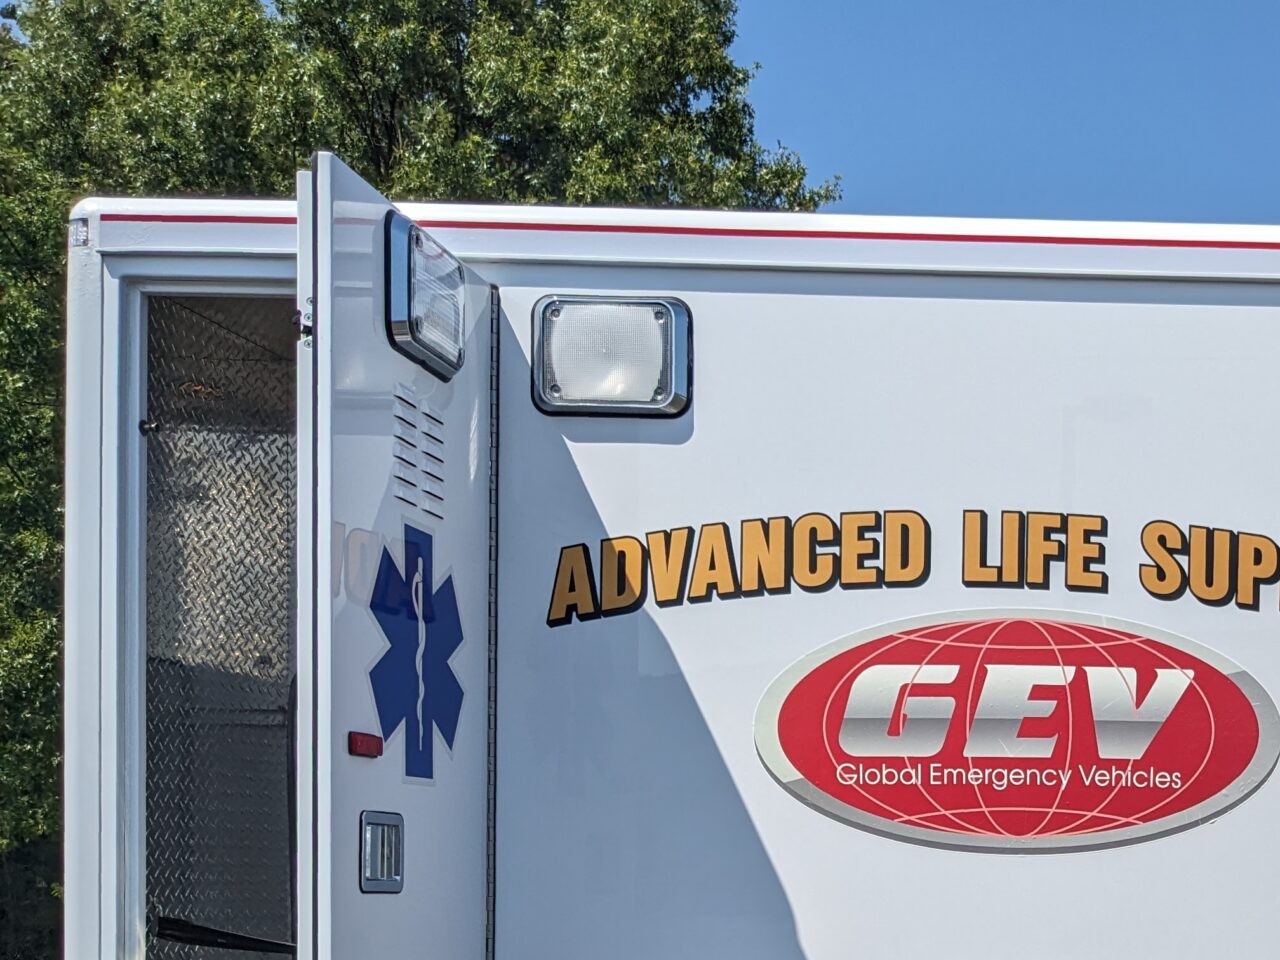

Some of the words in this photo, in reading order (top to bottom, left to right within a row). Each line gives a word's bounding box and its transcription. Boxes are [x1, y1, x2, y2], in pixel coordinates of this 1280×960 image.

[546, 509, 931, 628] ADVANCED
[962, 509, 1108, 594] LIFE
[838, 664, 1195, 760] GEV
[836, 763, 921, 786] Global
[930, 763, 1072, 790] Emergency
[1079, 765, 1182, 789] Vehicles
